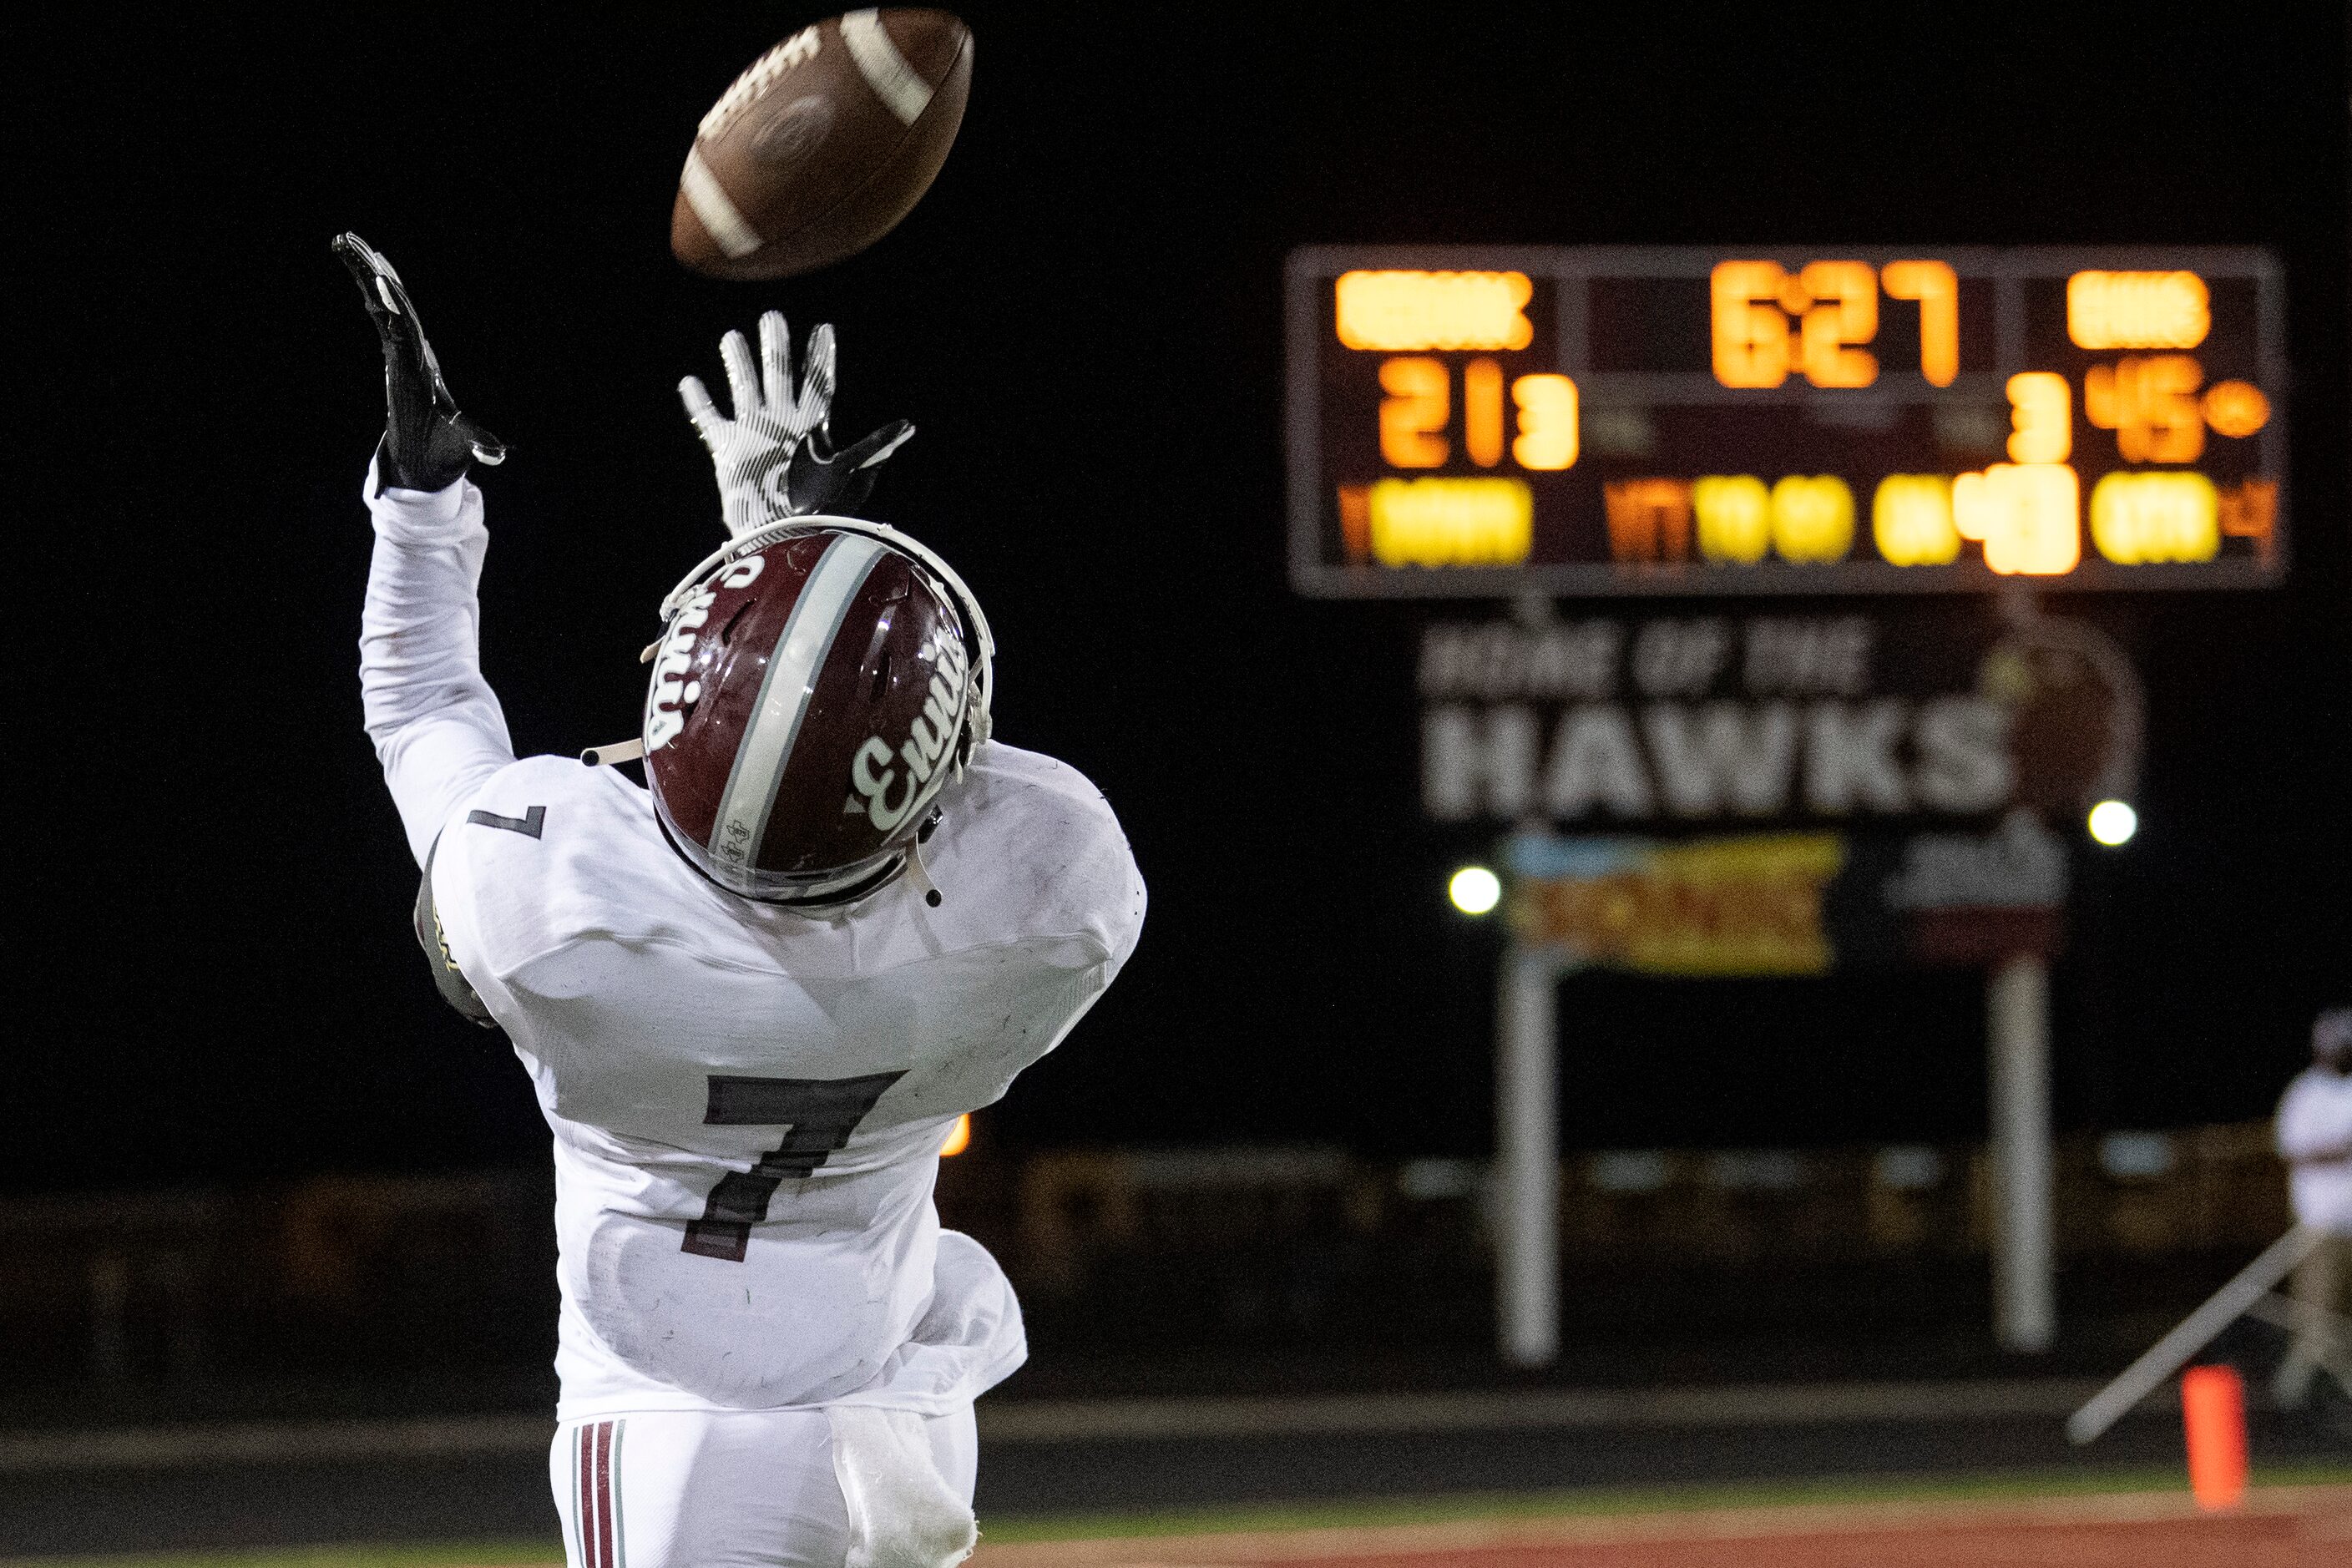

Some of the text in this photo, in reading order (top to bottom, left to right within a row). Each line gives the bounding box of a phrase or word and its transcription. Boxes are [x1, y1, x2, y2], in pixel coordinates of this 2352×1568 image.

[1709, 260, 1960, 388] 6:27
[1378, 357, 1504, 468] 21
[1511, 372, 1580, 470] 3
[2006, 371, 2071, 465] 3
[1419, 616, 1872, 696] HOME OF THE
[1421, 700, 2016, 821] HAWKS
[465, 805, 547, 841] 7
[680, 1069, 911, 1263] 7
